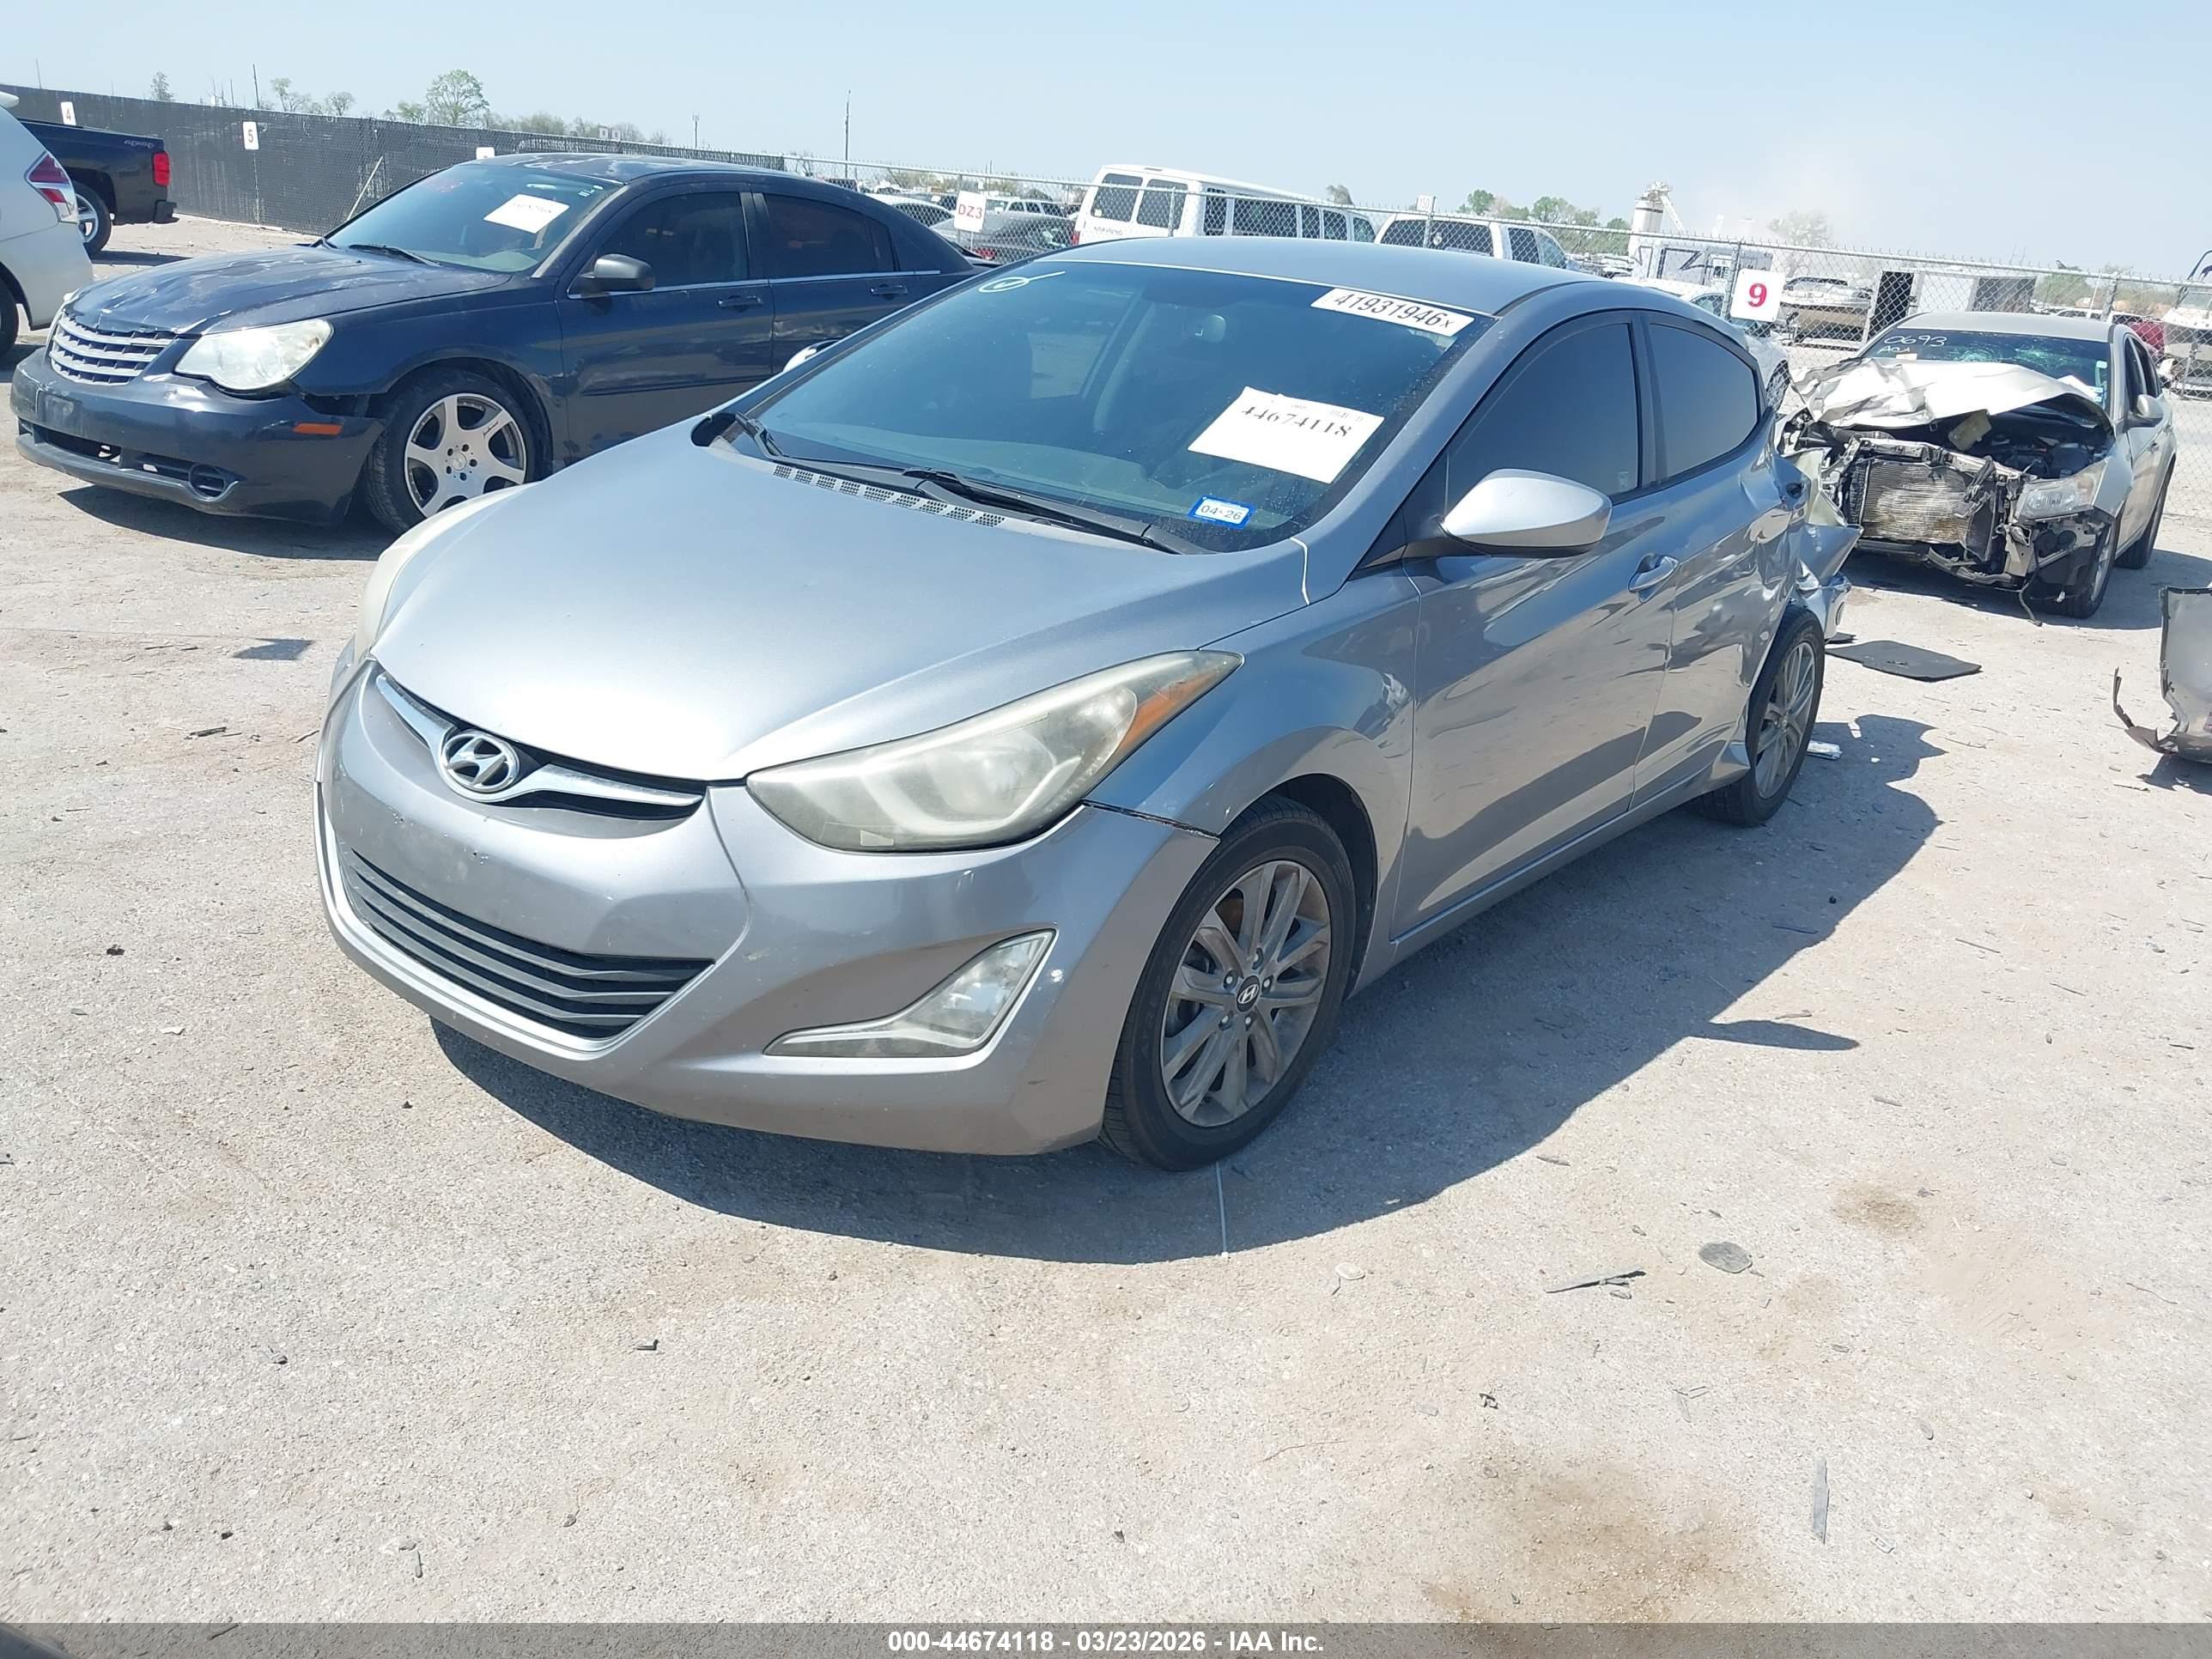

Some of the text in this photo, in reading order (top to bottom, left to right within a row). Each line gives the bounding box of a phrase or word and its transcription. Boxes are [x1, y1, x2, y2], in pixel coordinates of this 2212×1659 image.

[247, 129, 254, 143] 5
[958, 204, 983, 220] DZ3
[1747, 283, 1768, 307] 9
[1883, 335, 1948, 347] 0693
[1242, 406, 1352, 437] 44674118
